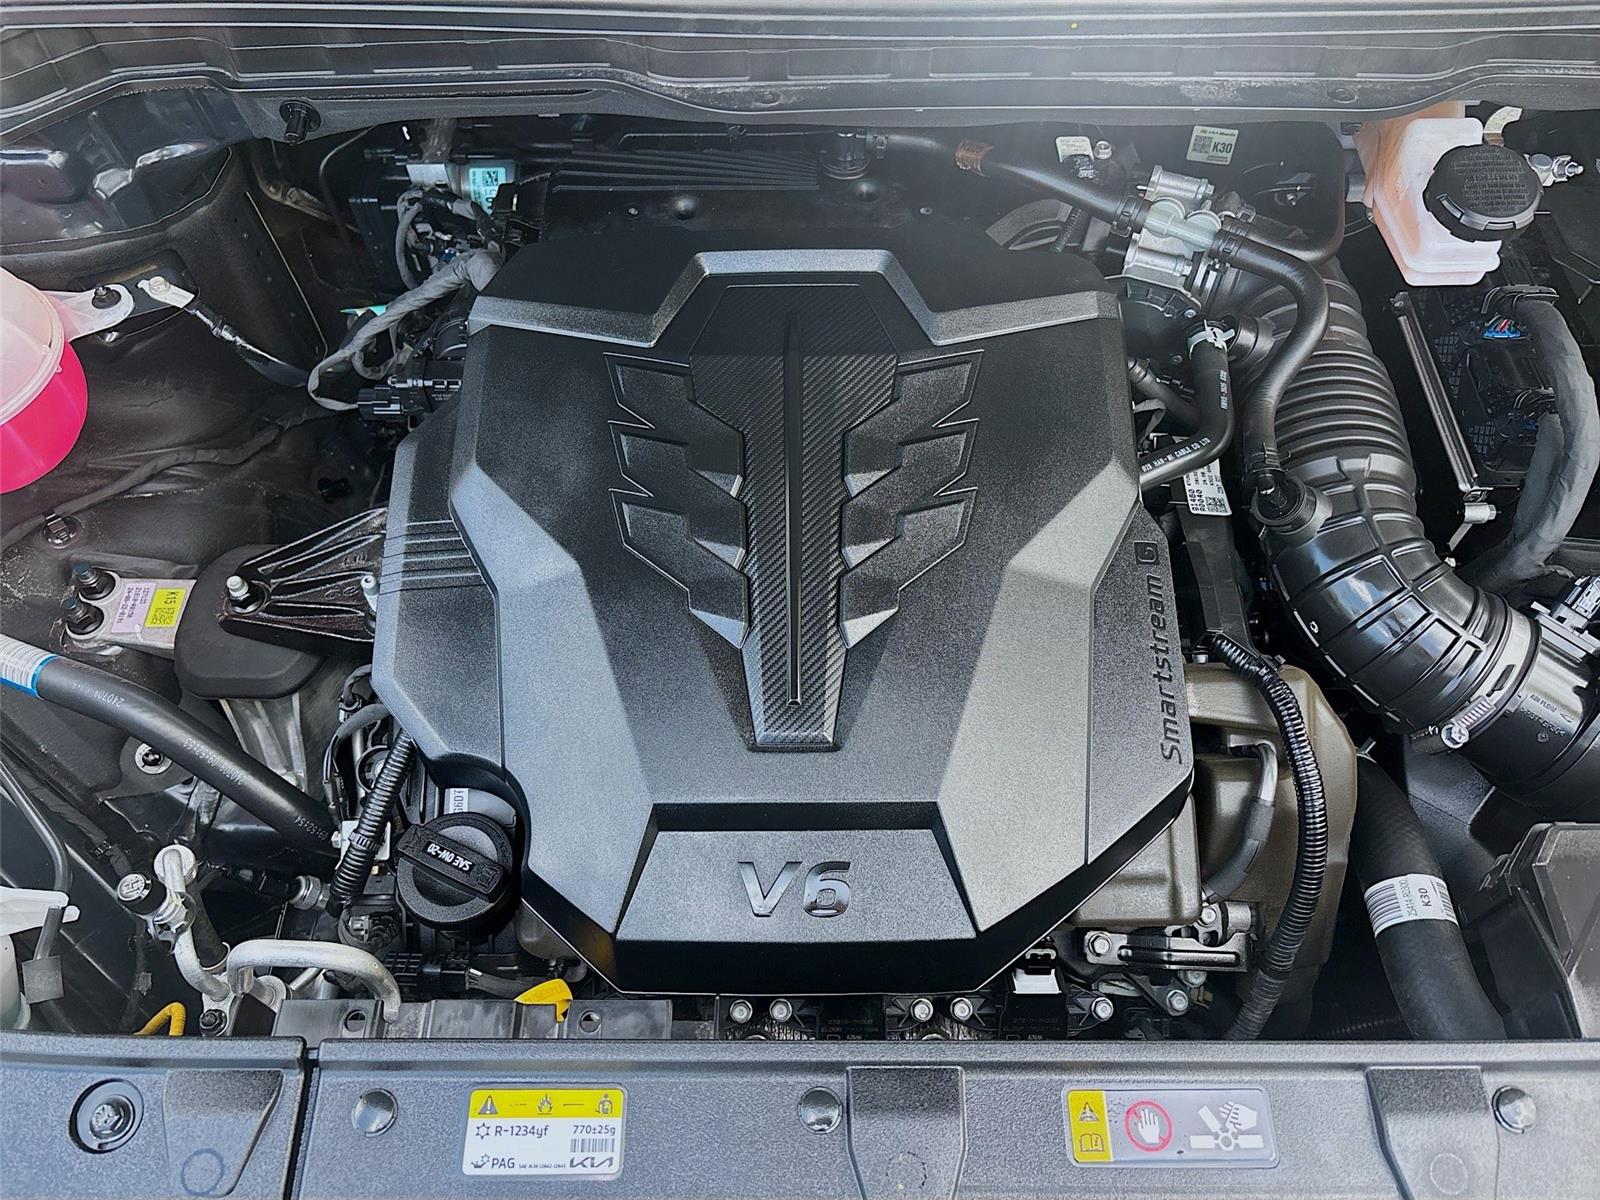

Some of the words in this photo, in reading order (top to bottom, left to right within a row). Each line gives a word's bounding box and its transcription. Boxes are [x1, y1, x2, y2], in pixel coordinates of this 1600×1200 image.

[1212, 141, 1233, 154] K30
[164, 591, 180, 605] K15
[1146, 574, 1182, 764] Smartstream
[426, 843, 455, 862] 0W-20
[452, 856, 473, 871] SAE
[737, 860, 851, 918] V6
[1418, 888, 1432, 907] K30
[494, 1125, 550, 1138] R-1234yf
[573, 1124, 616, 1136] 770±25g
[491, 1158, 516, 1169] PAG
[570, 1156, 614, 1168] KIA
